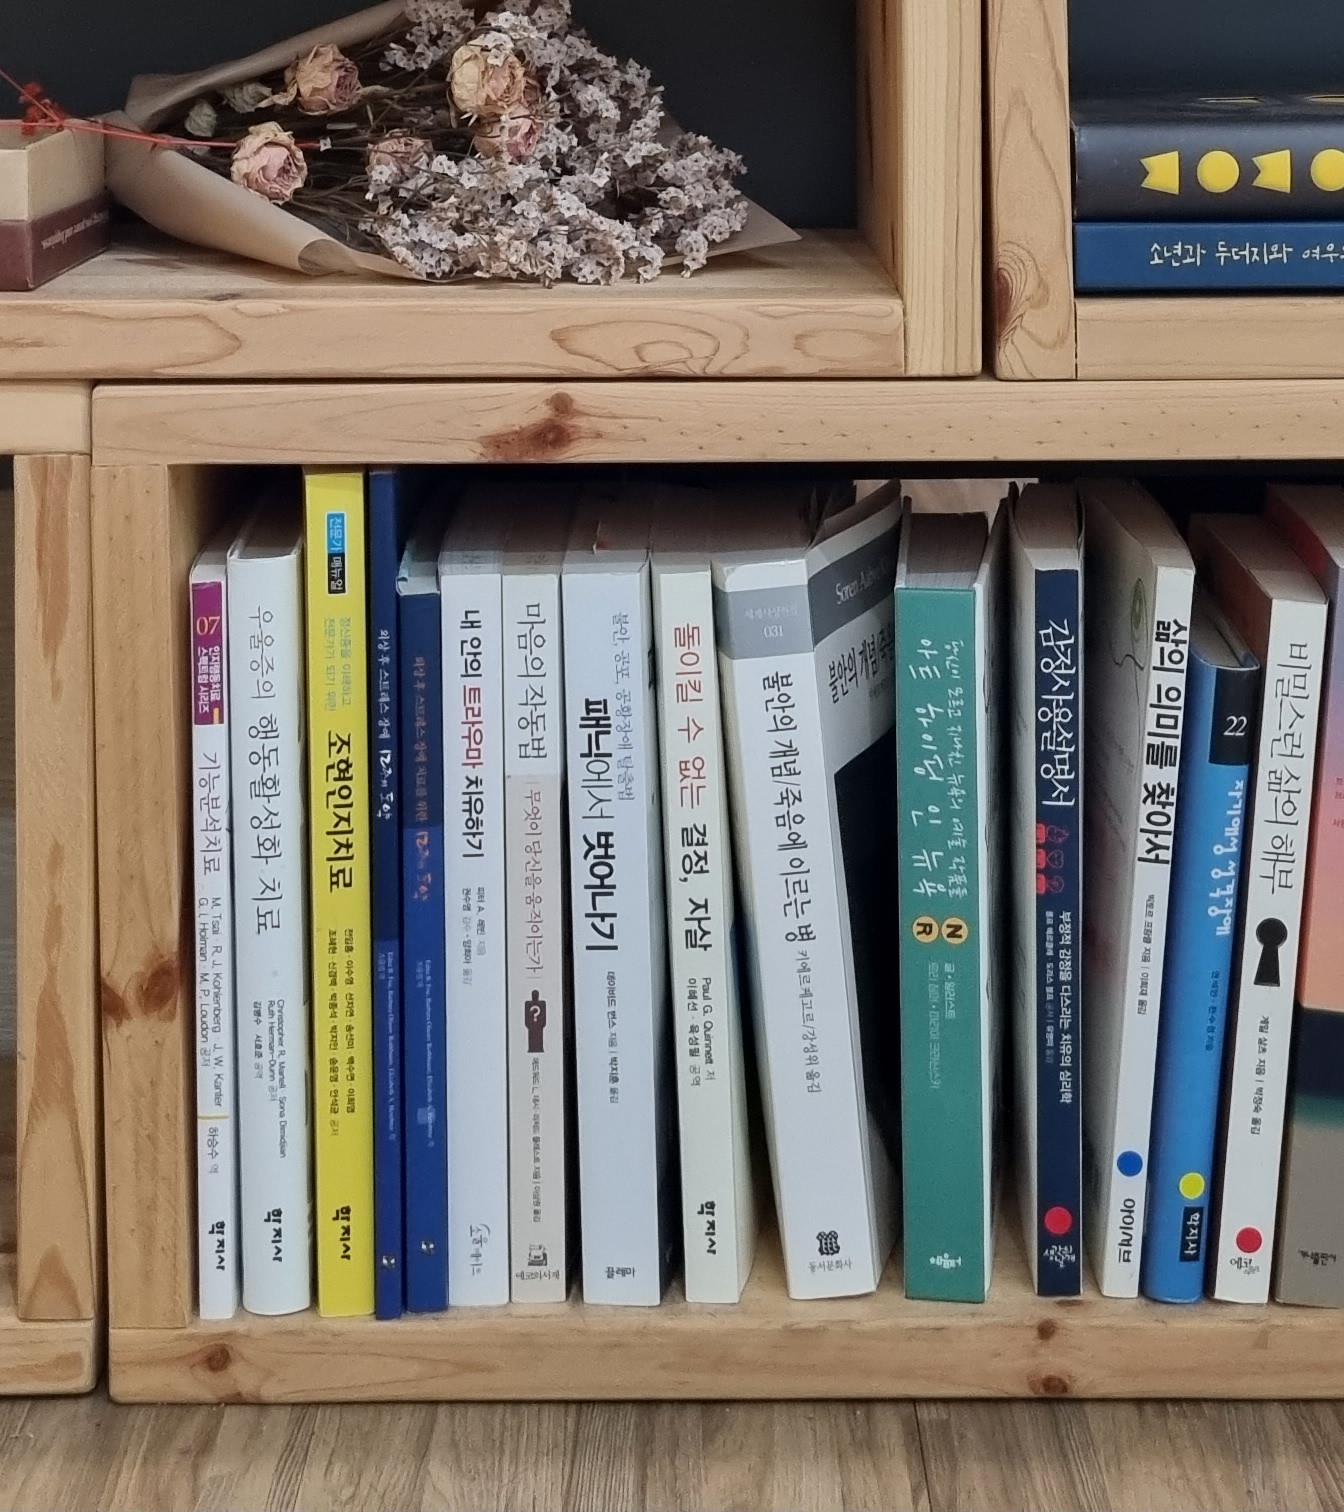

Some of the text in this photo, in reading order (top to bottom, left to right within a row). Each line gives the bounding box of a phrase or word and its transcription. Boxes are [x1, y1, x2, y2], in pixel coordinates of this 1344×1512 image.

[1149, 241, 1207, 266] 소년과
[1214, 240, 1294, 266] 두더지와
[196, 615, 222, 635] 07
[328, 515, 344, 591] 전문가 매뉴얼
[459, 609, 485, 859] 내 안의 트라우마 치유하기
[517, 602, 548, 760] 마음의 작동법
[1040, 618, 1076, 807] 감정사용설명서
[1137, 618, 1188, 866] 삶의 의미를 찾아서
[1223, 715, 1249, 738] 22
[197, 752, 222, 877] 기능분석치료
[247, 605, 283, 935] 우울증의 행동활성화 치료
[325, 731, 356, 893] 조현인지치료
[579, 697, 619, 951] 패닉에서 벗어나기
[675, 622, 713, 952] 돌이킬 수 없는 결정, 자살
[763, 670, 817, 943] 불안의 이르는 병
[1258, 642, 1313, 896] 비밀스런 삶의 해부
[524, 788, 544, 972] 무엇이 당신을 움직이는가
[268, 1000, 278, 1020] Ruth
[276, 999, 287, 1046] Christopher
[702, 977, 713, 1001] Paul
[1059, 910, 1073, 1104] 부정적 감정을 다스리는 치유의 심리학
[264, 1207, 283, 1263] 학지사
[333, 1205, 351, 1262] 학지사
[697, 1200, 717, 1255] 학지사
